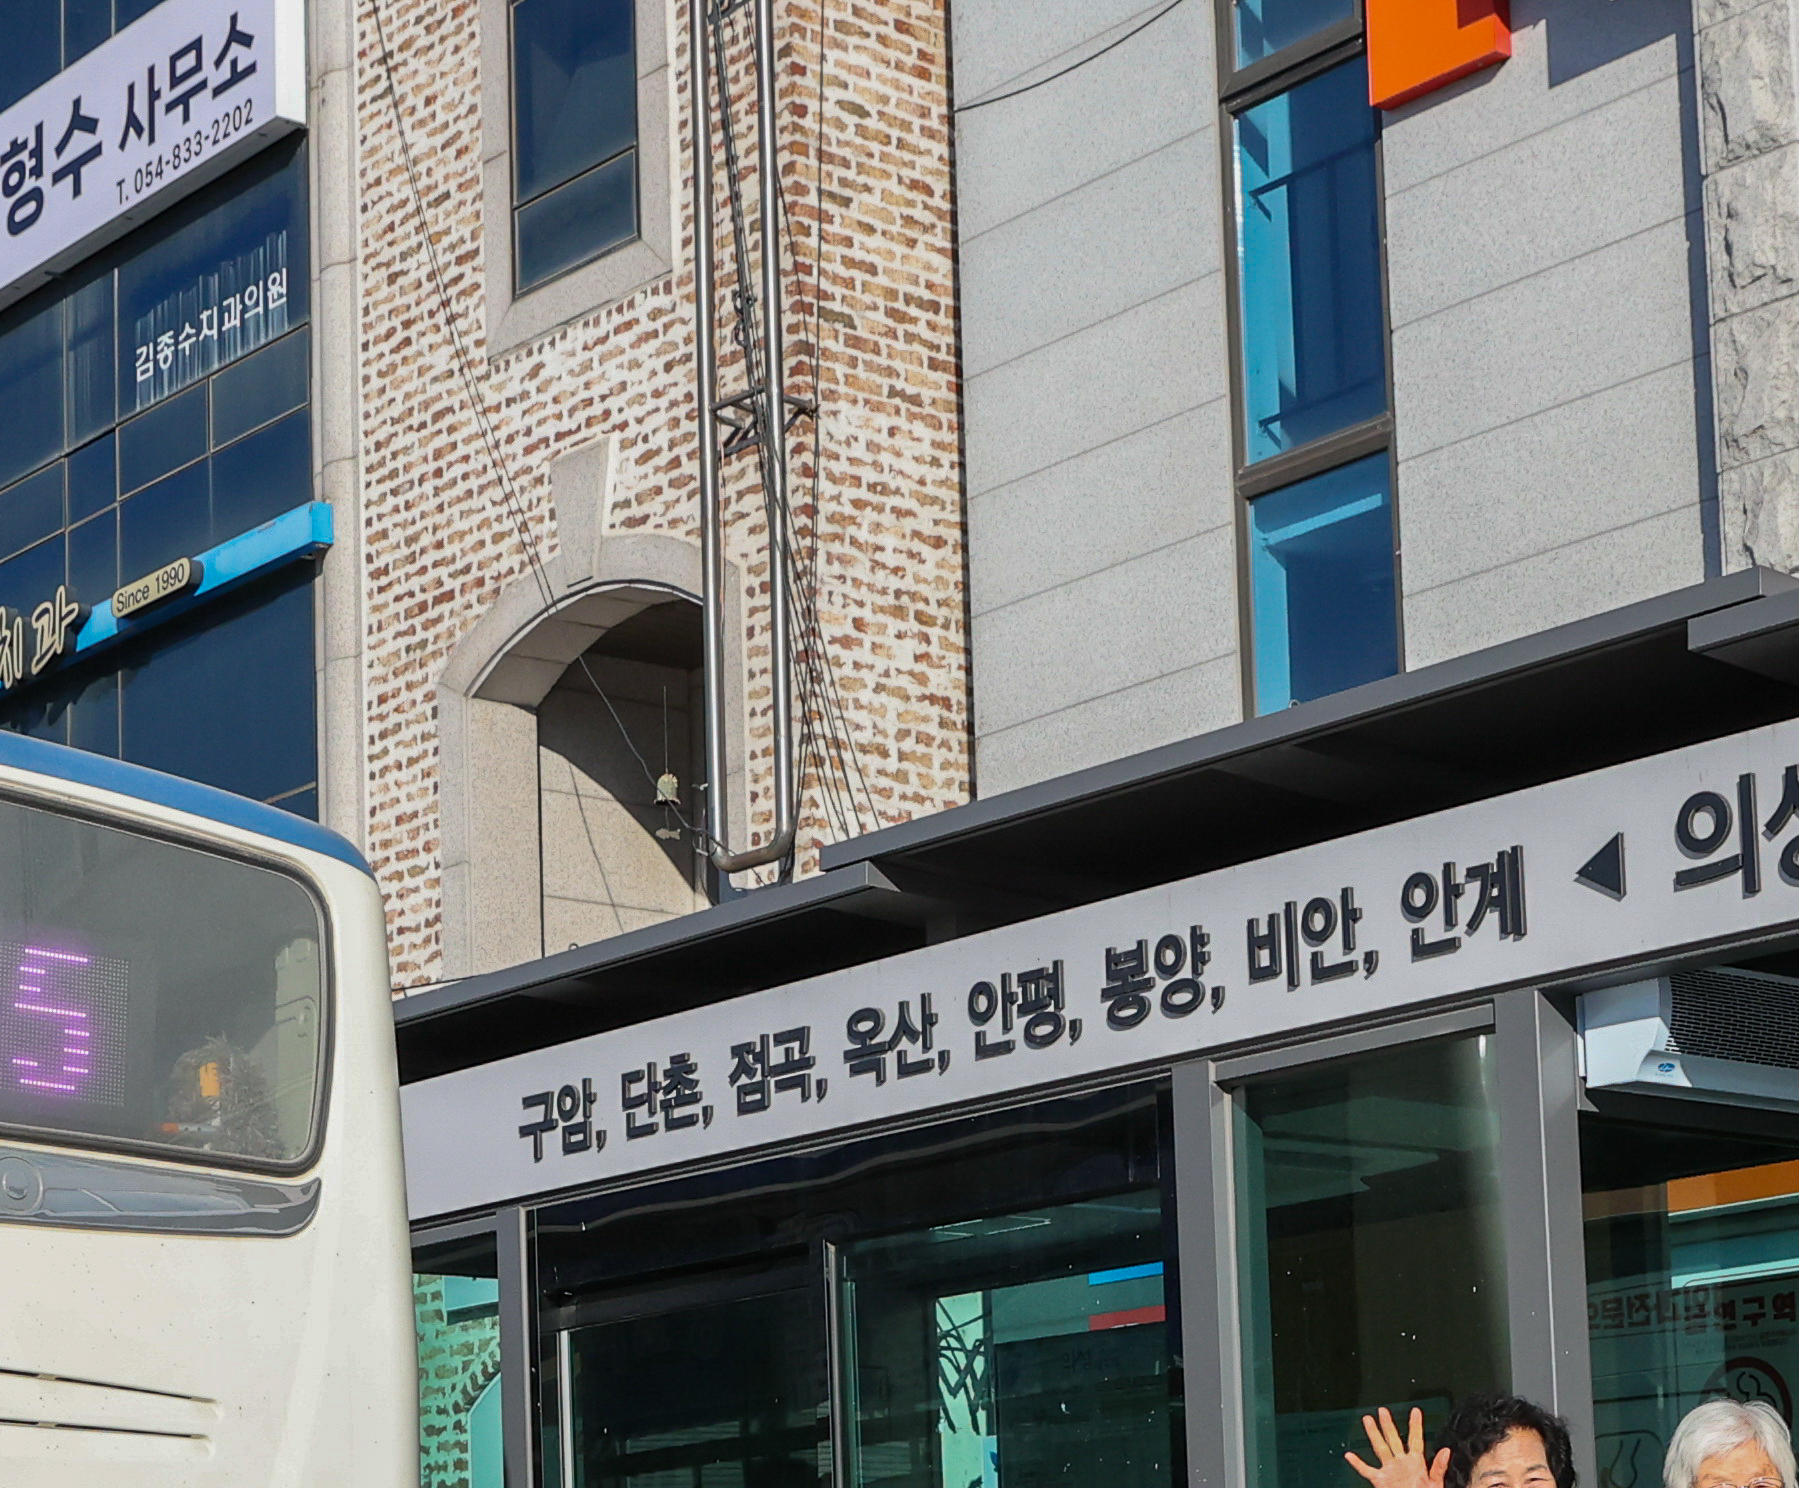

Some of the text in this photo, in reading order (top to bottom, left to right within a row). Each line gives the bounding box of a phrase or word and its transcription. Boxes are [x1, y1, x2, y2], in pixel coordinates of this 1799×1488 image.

[117, 12, 258, 152] 사무소
[115, 98, 254, 206] T. 054-833-2202
[135, 267, 288, 383] 김종수치과의원
[115, 562, 186, 614] Since 1990
[518, 845, 1529, 1162] 구암, 단촌, 점곡, 옥산, 안평, 봉양, 비안, 안계
